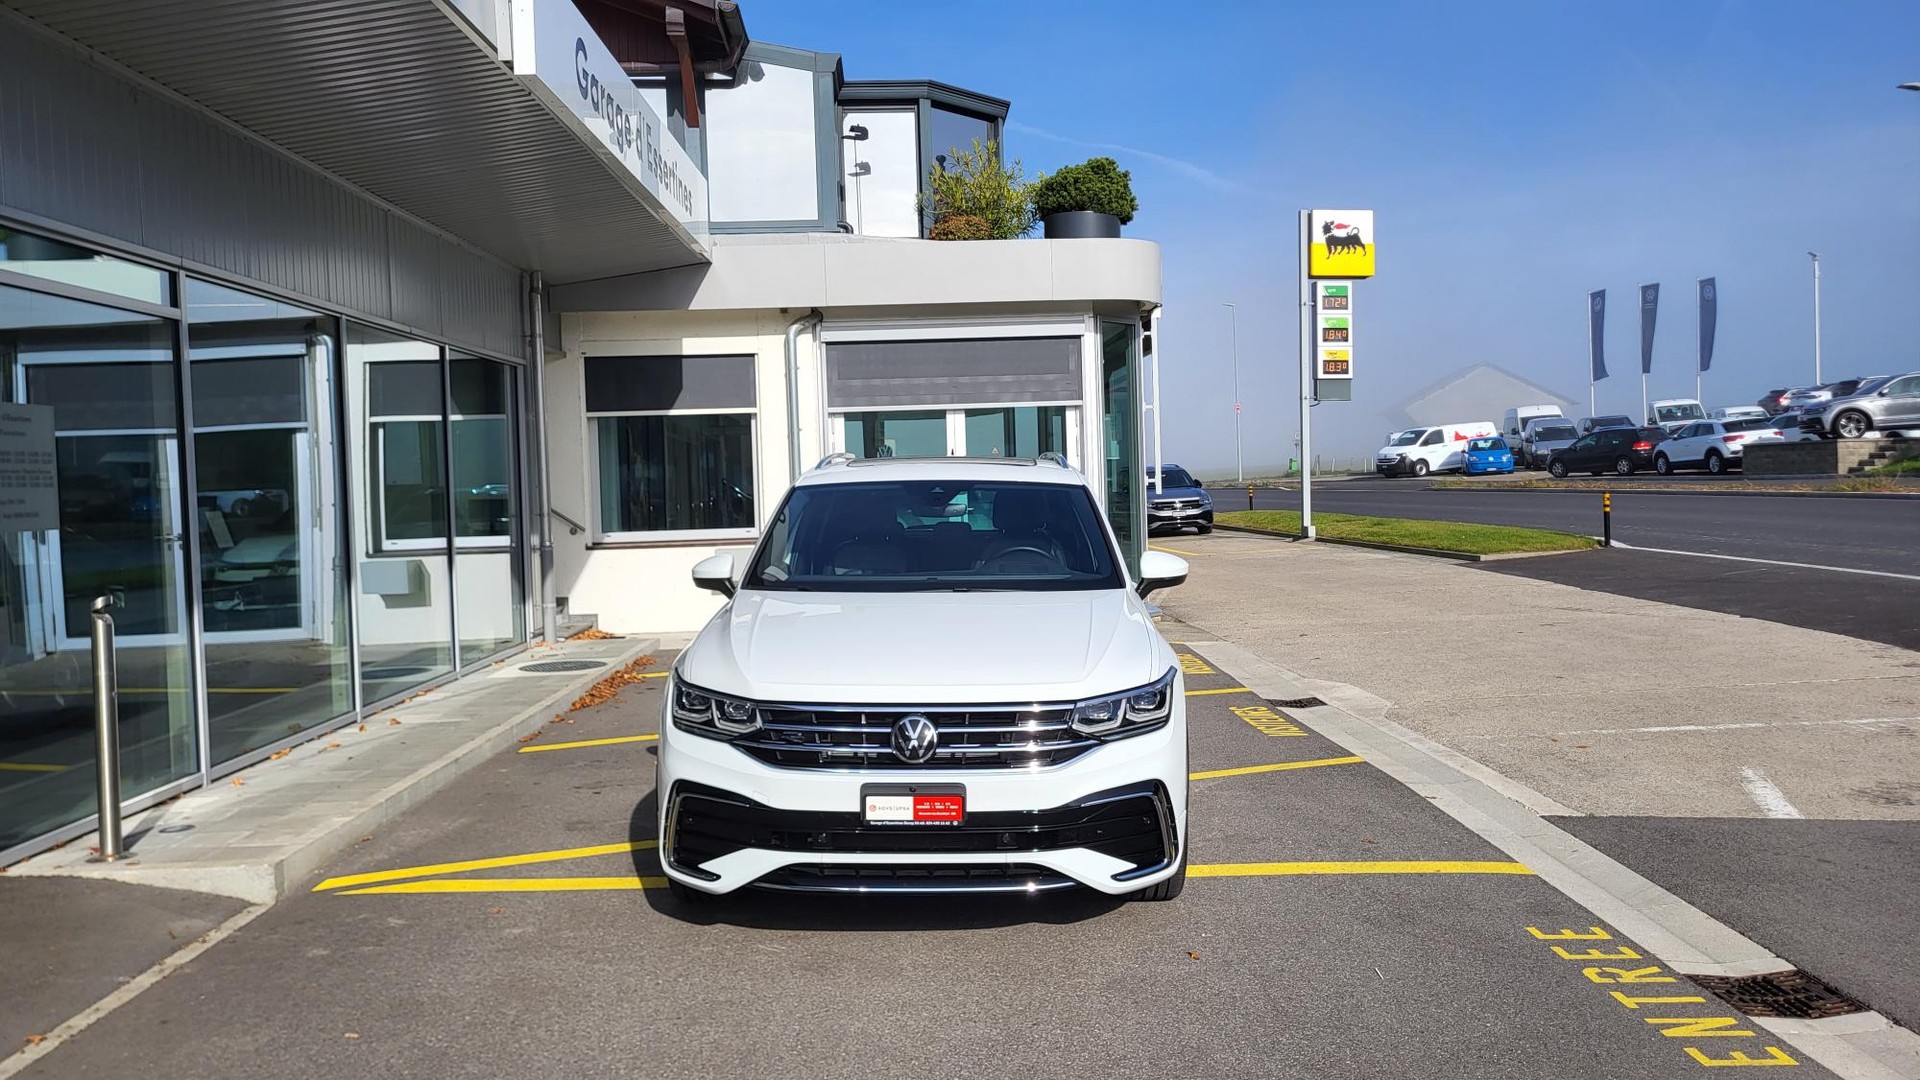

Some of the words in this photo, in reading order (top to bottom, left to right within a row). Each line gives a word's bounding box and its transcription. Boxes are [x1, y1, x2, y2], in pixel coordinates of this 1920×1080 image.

[575, 37, 631, 154] Garage
[635, 112, 693, 217] d'Essertines
[892, 714, 938, 763] VW
[1525, 926, 1799, 1067] ENTREE
